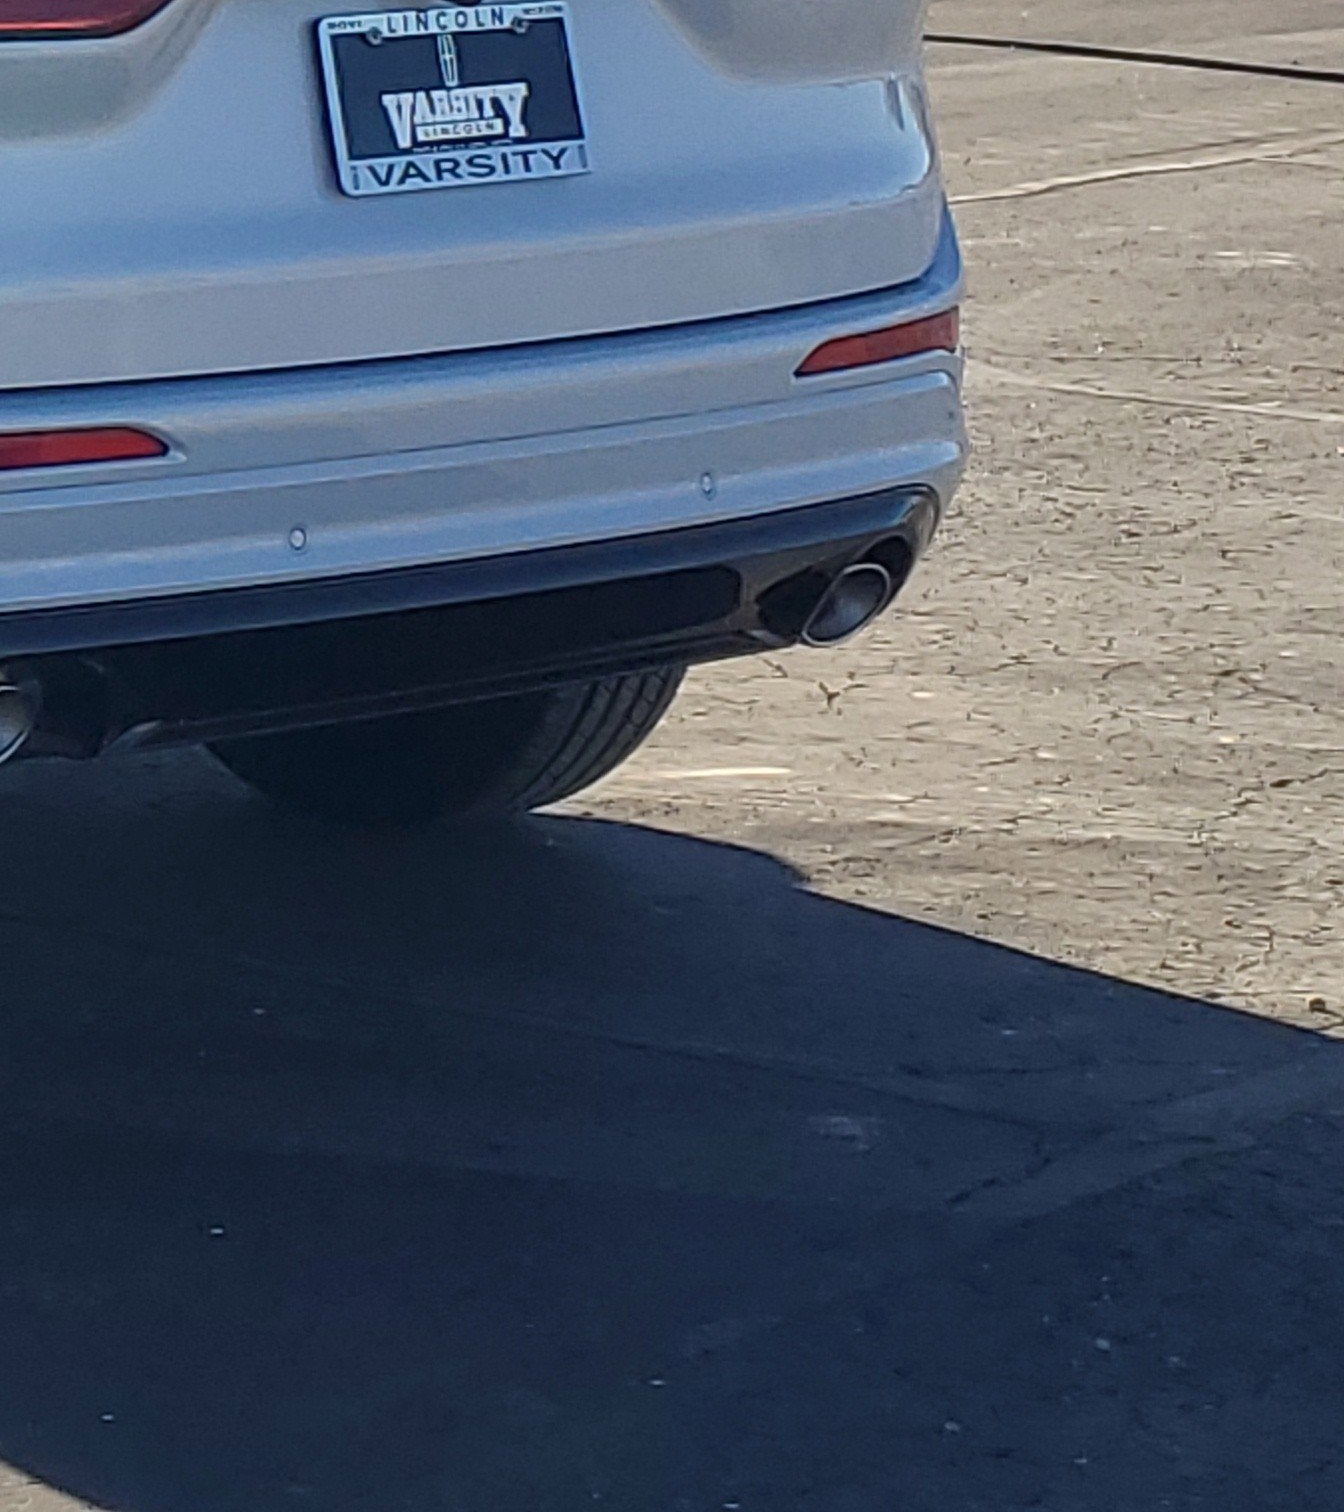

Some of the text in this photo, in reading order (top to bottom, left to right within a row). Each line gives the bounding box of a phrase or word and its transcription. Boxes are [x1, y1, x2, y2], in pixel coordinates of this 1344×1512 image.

[386, 6, 505, 35] LINCOLN
[381, 82, 529, 149] VARSITY
[421, 121, 496, 138] LINCOLN
[366, 147, 568, 187] VARSITY
